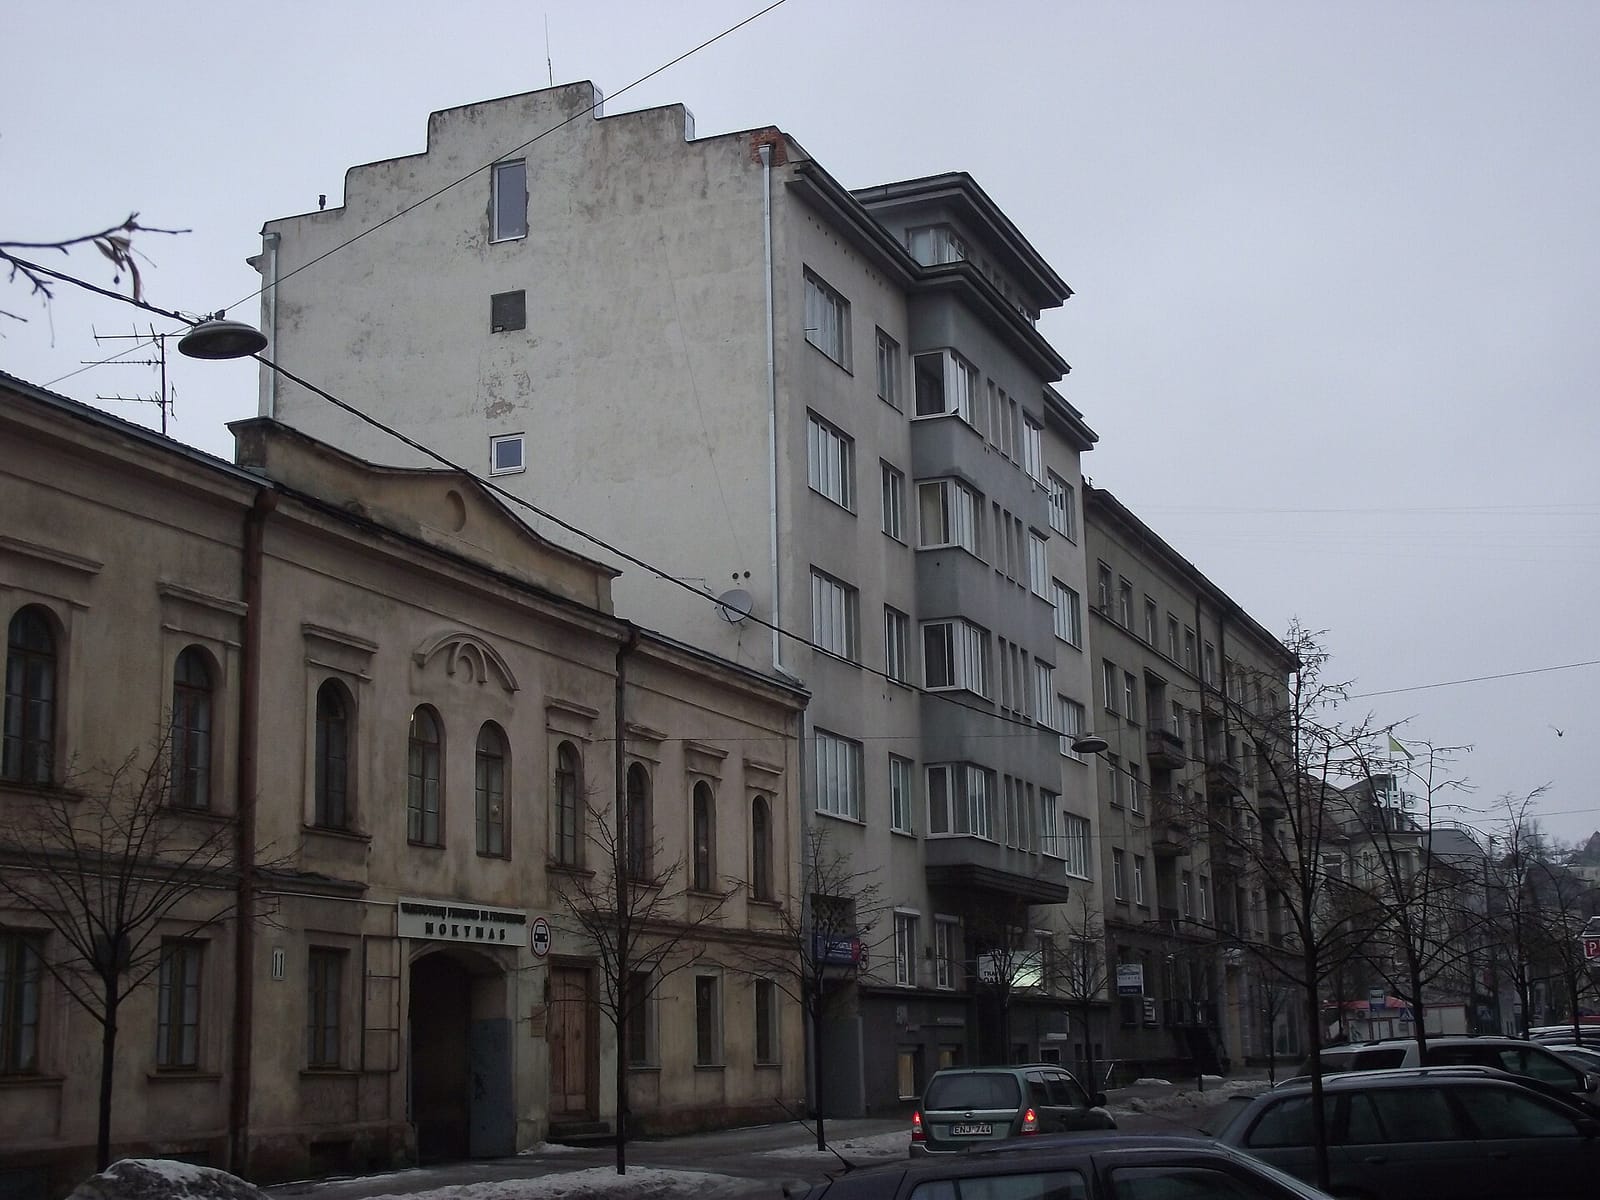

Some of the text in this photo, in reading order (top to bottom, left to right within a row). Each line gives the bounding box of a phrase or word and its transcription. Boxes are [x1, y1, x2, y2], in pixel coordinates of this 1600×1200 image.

[1372, 789, 1416, 808] SEB
[425, 922, 506, 941] MOKYMAS
[1589, 941, 1597, 955] P
[274, 952, 283, 976] 11
